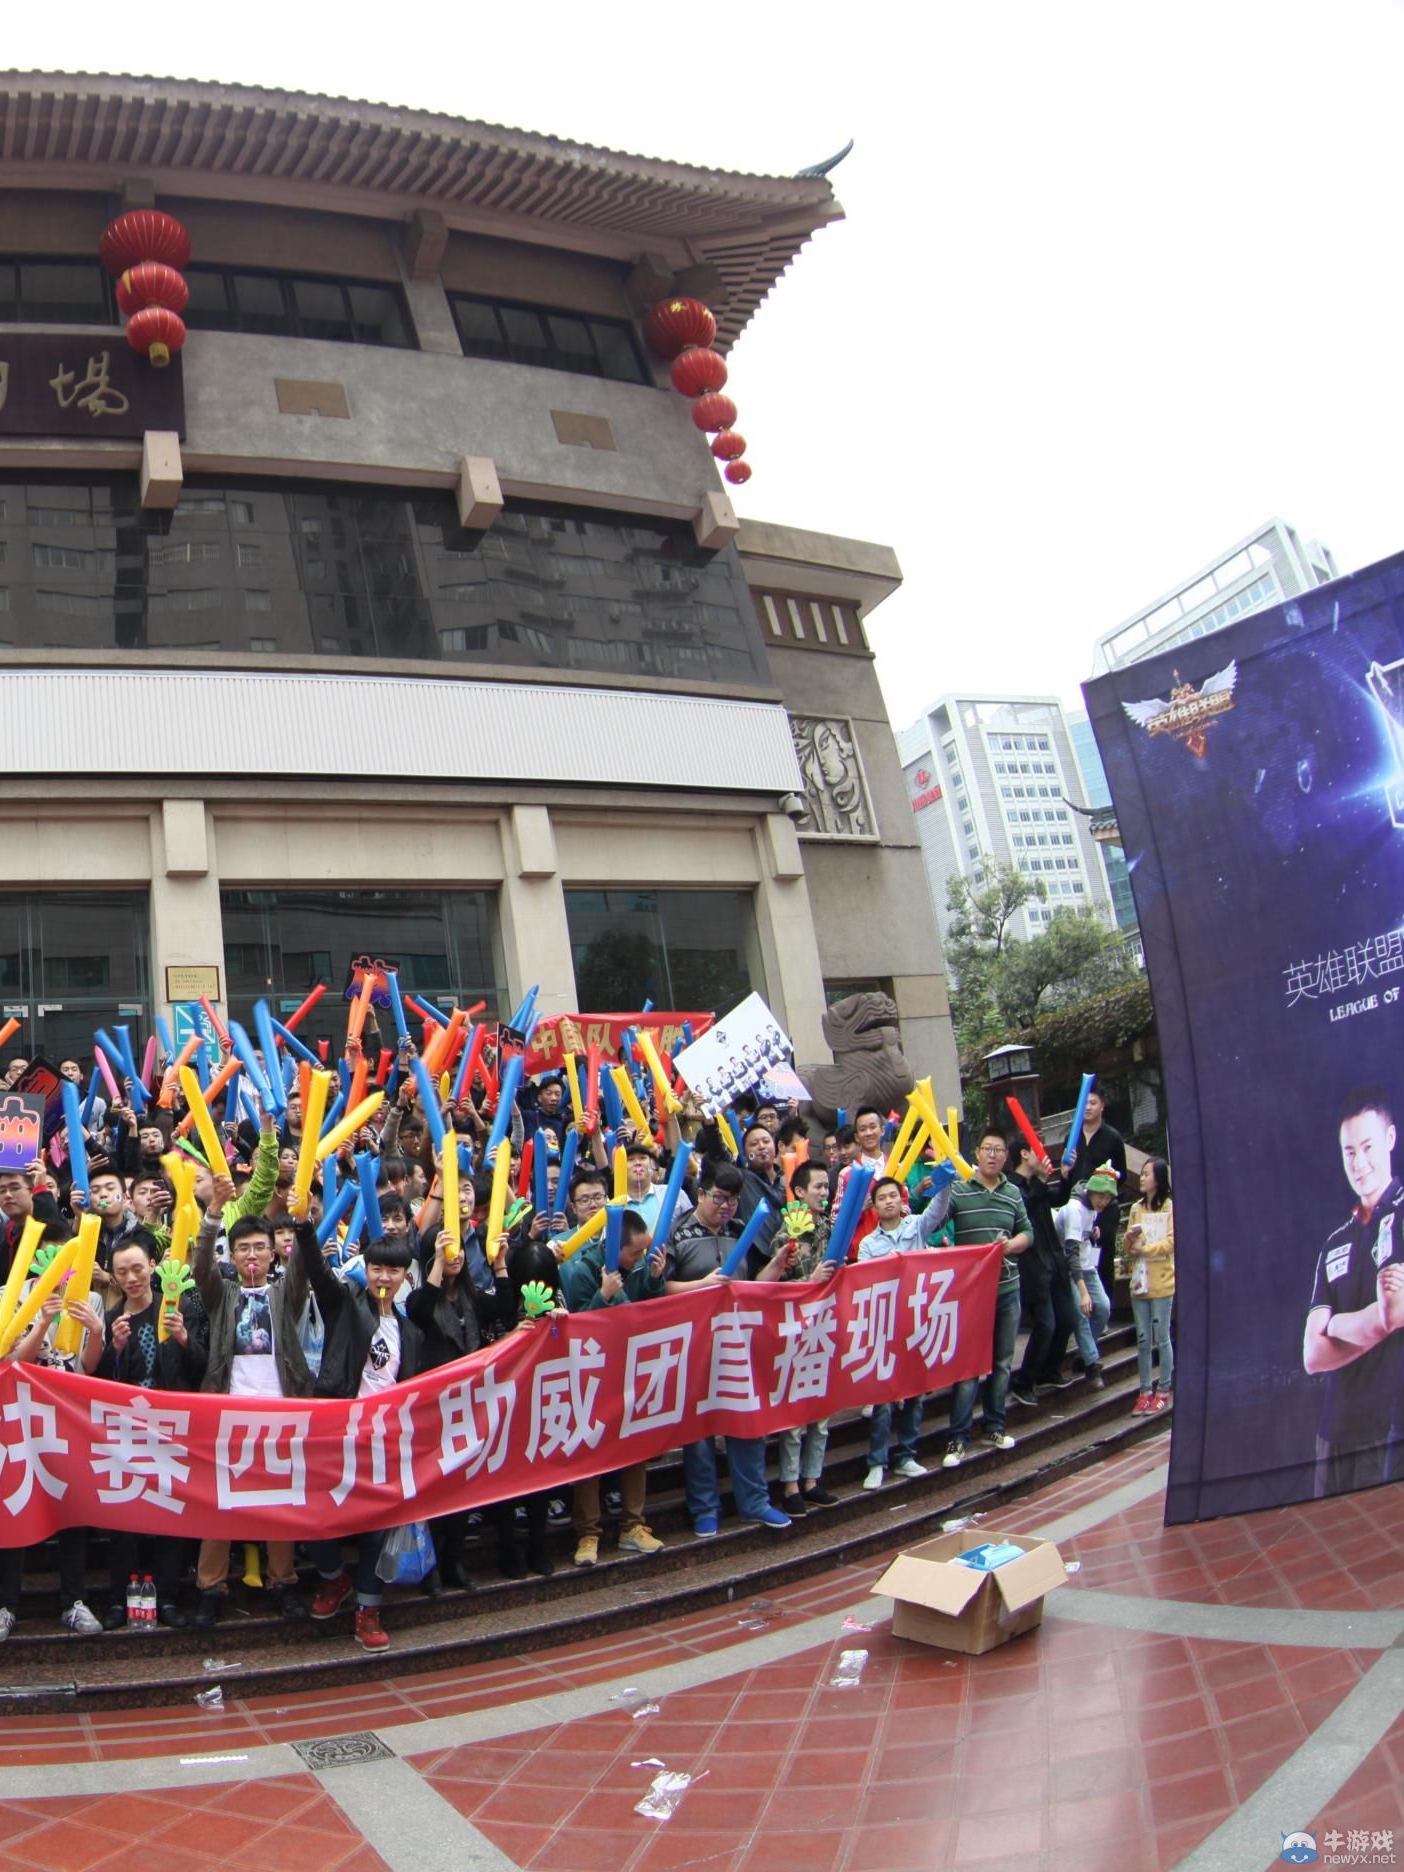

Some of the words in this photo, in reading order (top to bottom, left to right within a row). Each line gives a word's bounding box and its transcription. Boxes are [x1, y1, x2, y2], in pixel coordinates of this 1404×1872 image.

[1282, 929, 1404, 1008] 英雄联盟
[1329, 994, 1378, 1022] LEAGUE
[1383, 986, 1400, 1004] OF
